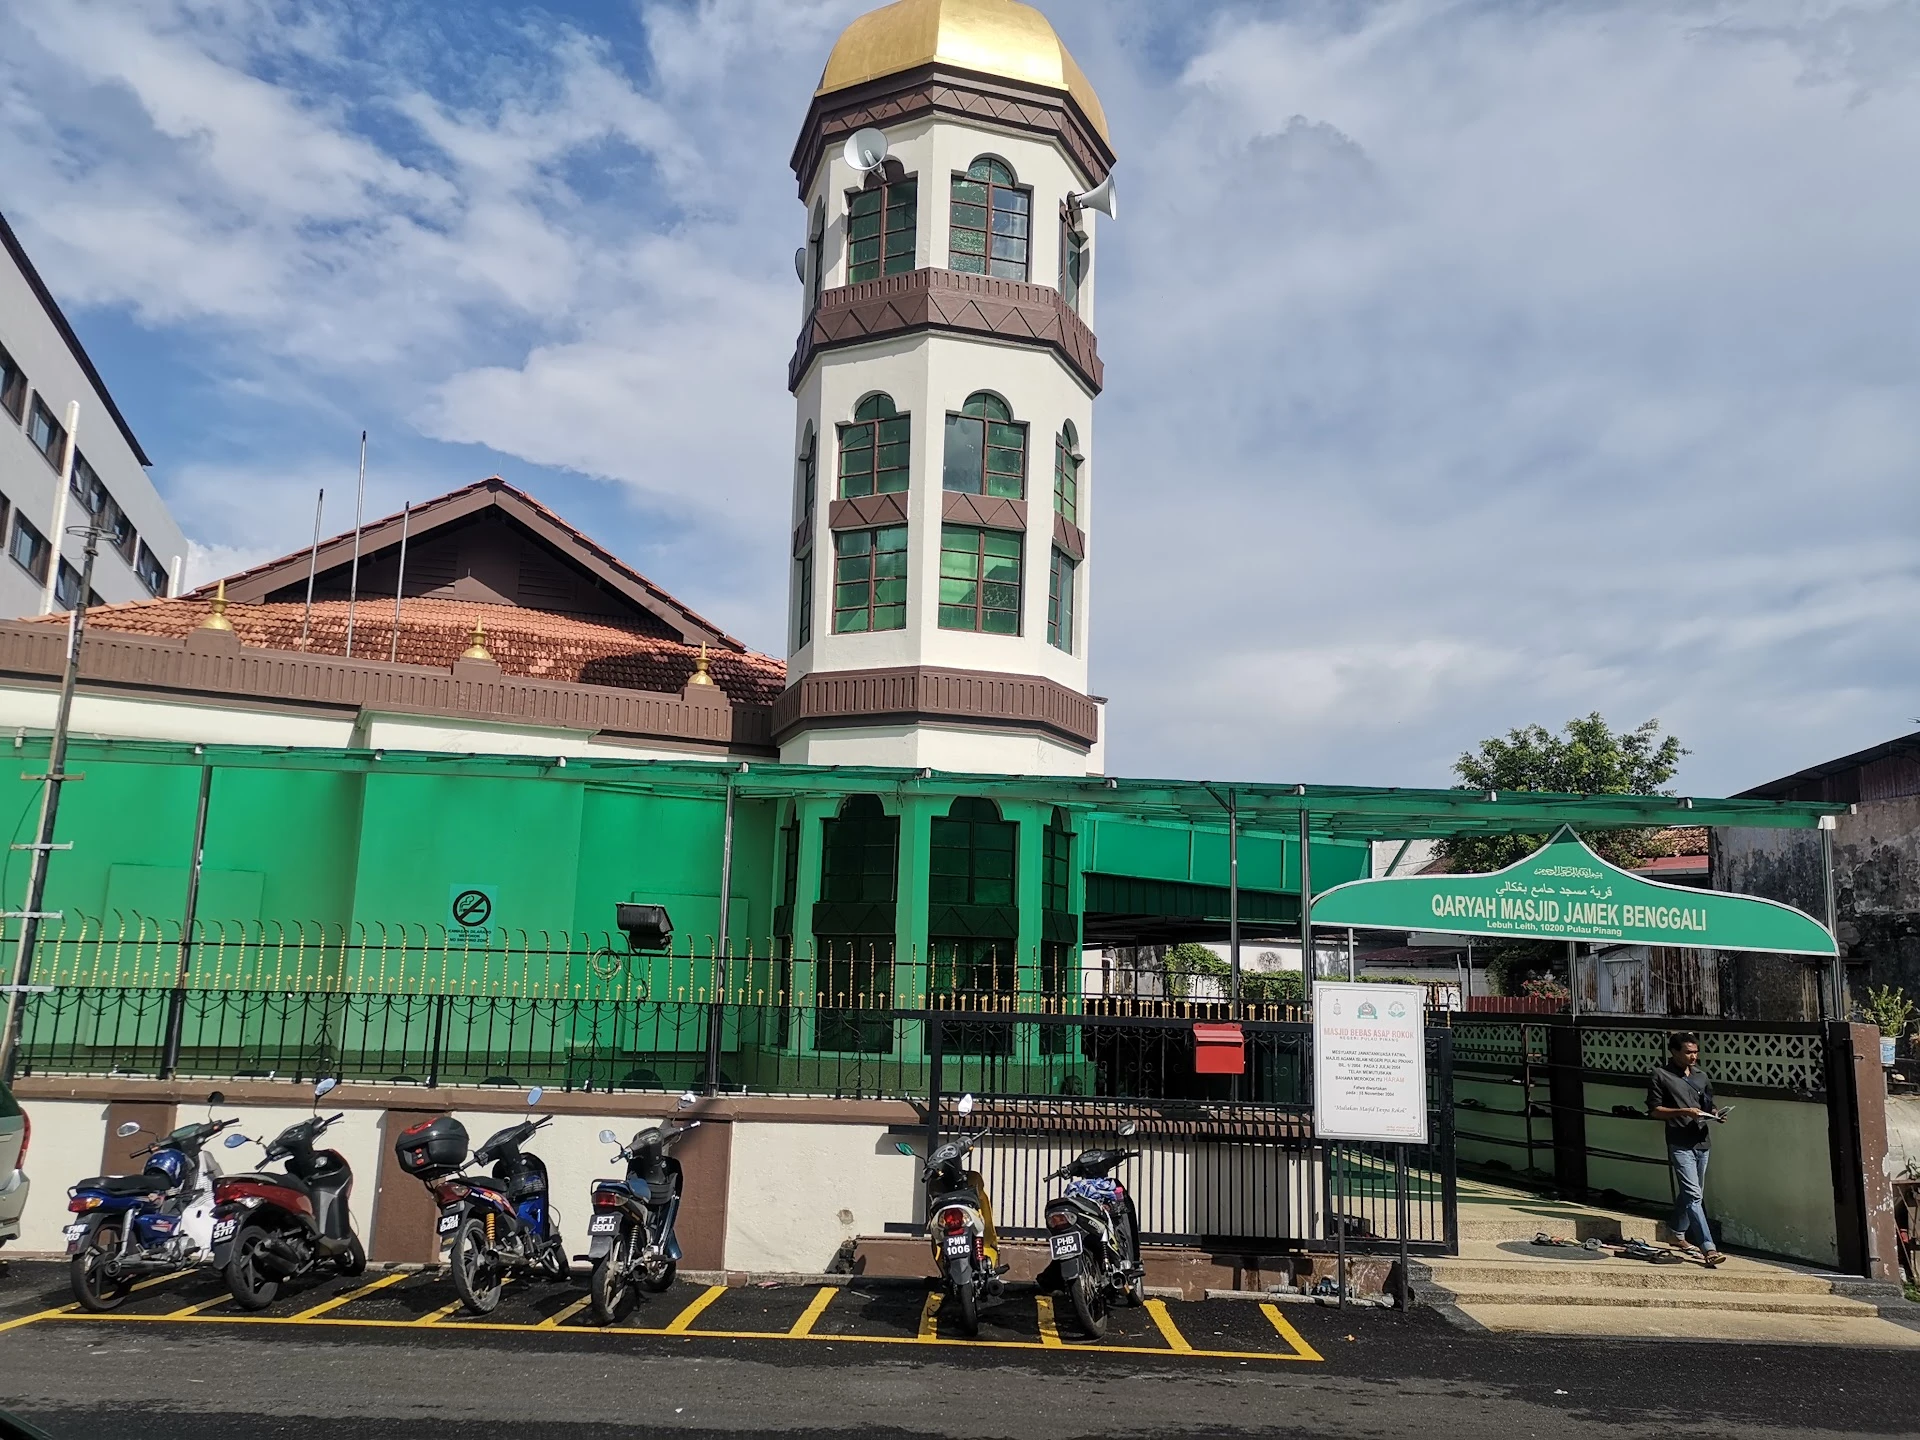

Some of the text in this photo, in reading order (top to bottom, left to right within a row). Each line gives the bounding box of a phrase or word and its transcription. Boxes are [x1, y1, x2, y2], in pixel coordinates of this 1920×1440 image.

[1560, 886, 1588, 897] مسجد
[1590, 885, 1613, 900] قرية
[1431, 894, 1707, 931] QARYAH MASJID JAMEK BENGGALI
[1486, 920, 1622, 936] Lebuh Leith, 10200 Pulau Pinang
[1350, 1029, 1371, 1037] BEBAS
[1392, 1030, 1414, 1039] ROKOK
[216, 1220, 234, 1230] PLB
[596, 1216, 614, 1224] PFT
[214, 1226, 236, 1238] 5717
[1056, 1235, 1074, 1245] PHB
[947, 1245, 970, 1256] 1006
[1056, 1245, 1077, 1255] 4904
